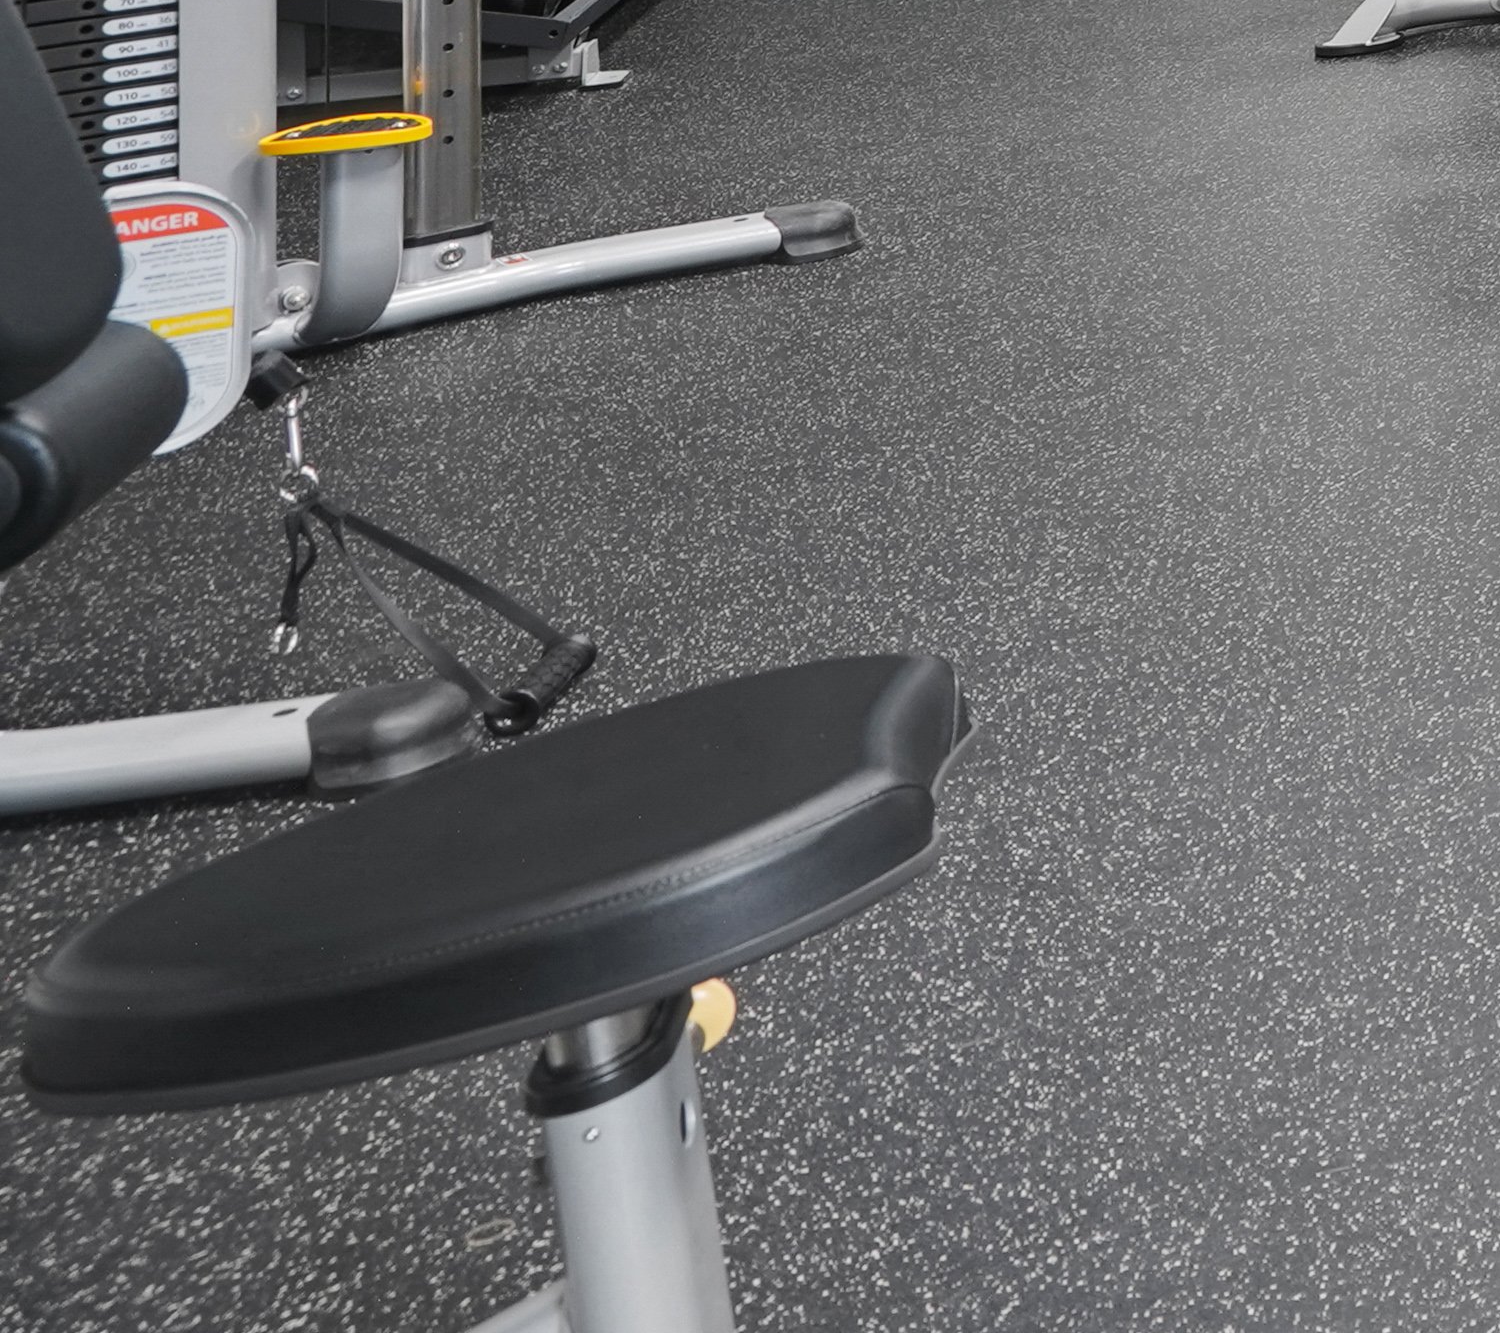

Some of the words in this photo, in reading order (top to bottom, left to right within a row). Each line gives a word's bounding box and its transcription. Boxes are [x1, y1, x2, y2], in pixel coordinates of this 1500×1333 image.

[118, 20, 134, 30] 80
[118, 44, 134, 54] 90
[116, 68, 138, 78] 100
[118, 91, 138, 101] 110
[116, 116, 137, 125] 120
[116, 139, 137, 149] 130
[116, 162, 137, 172] 140
[115, 210, 199, 237] ANGER
